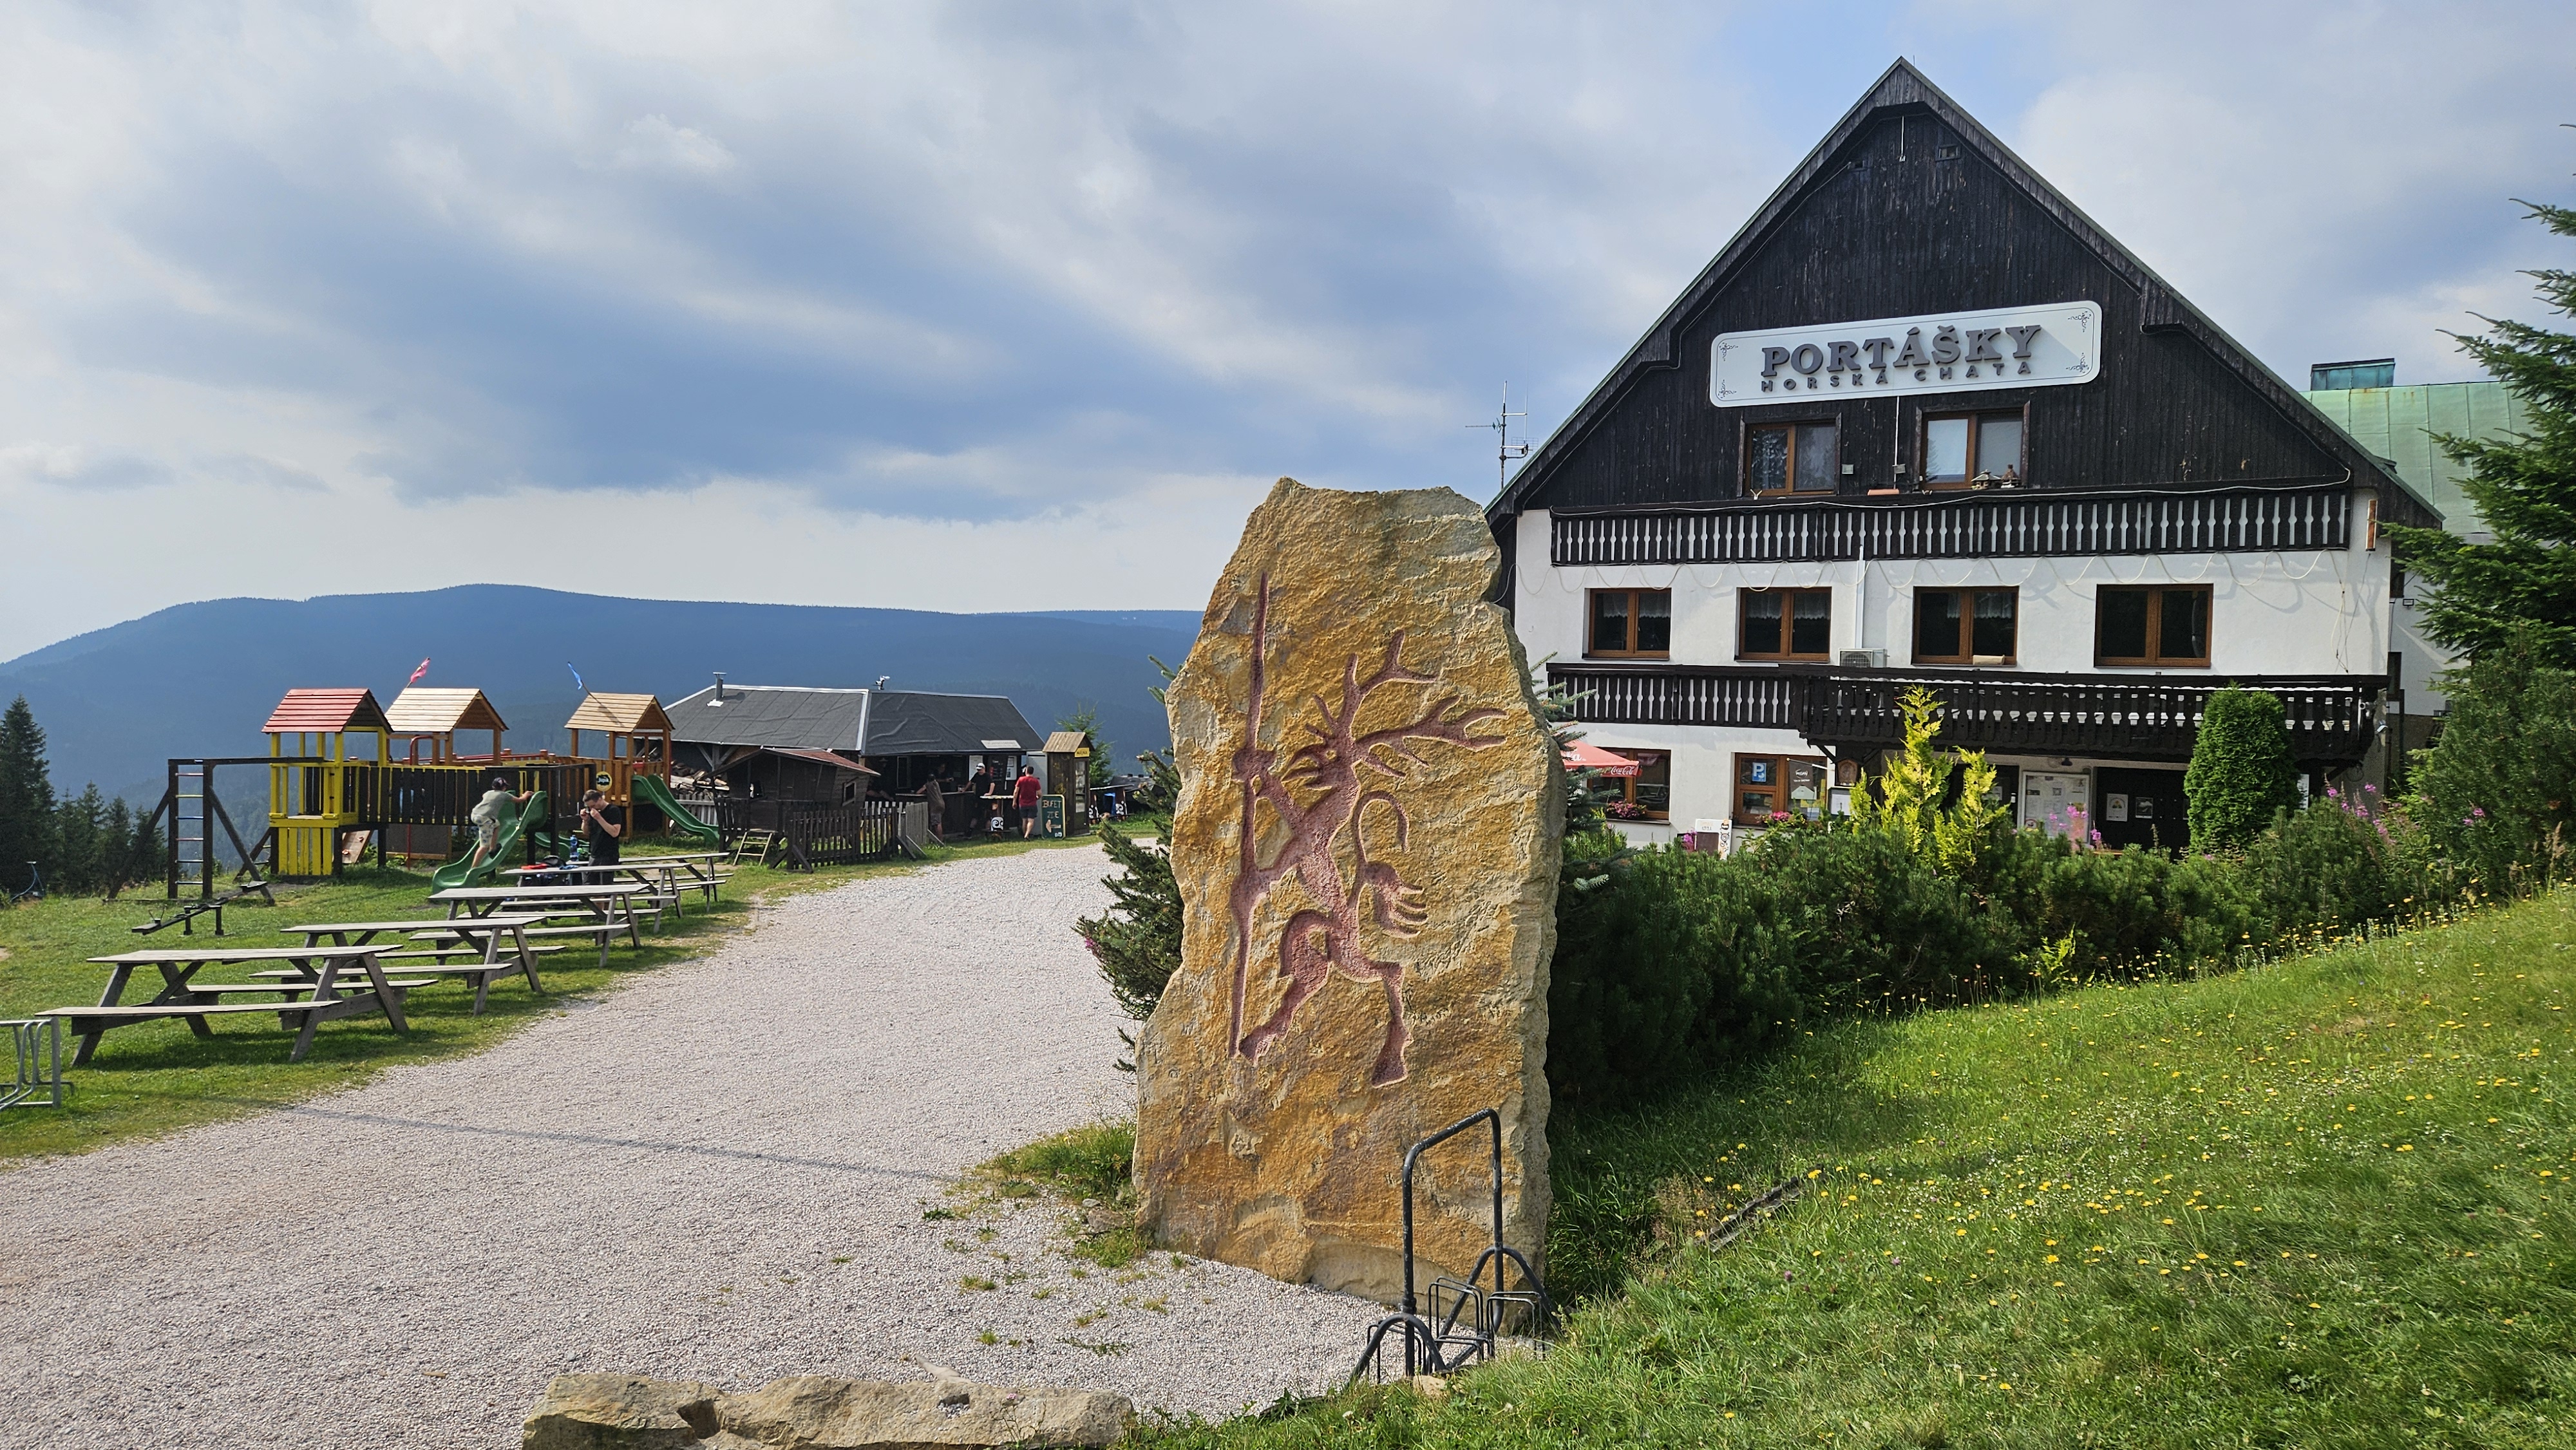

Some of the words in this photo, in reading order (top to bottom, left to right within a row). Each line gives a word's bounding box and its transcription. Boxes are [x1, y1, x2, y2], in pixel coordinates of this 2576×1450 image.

[1761, 325, 2041, 377] PORTÁŠKY
[1761, 370, 1888, 392] HORSKÁ
[1914, 361, 2032, 381] CHATA
